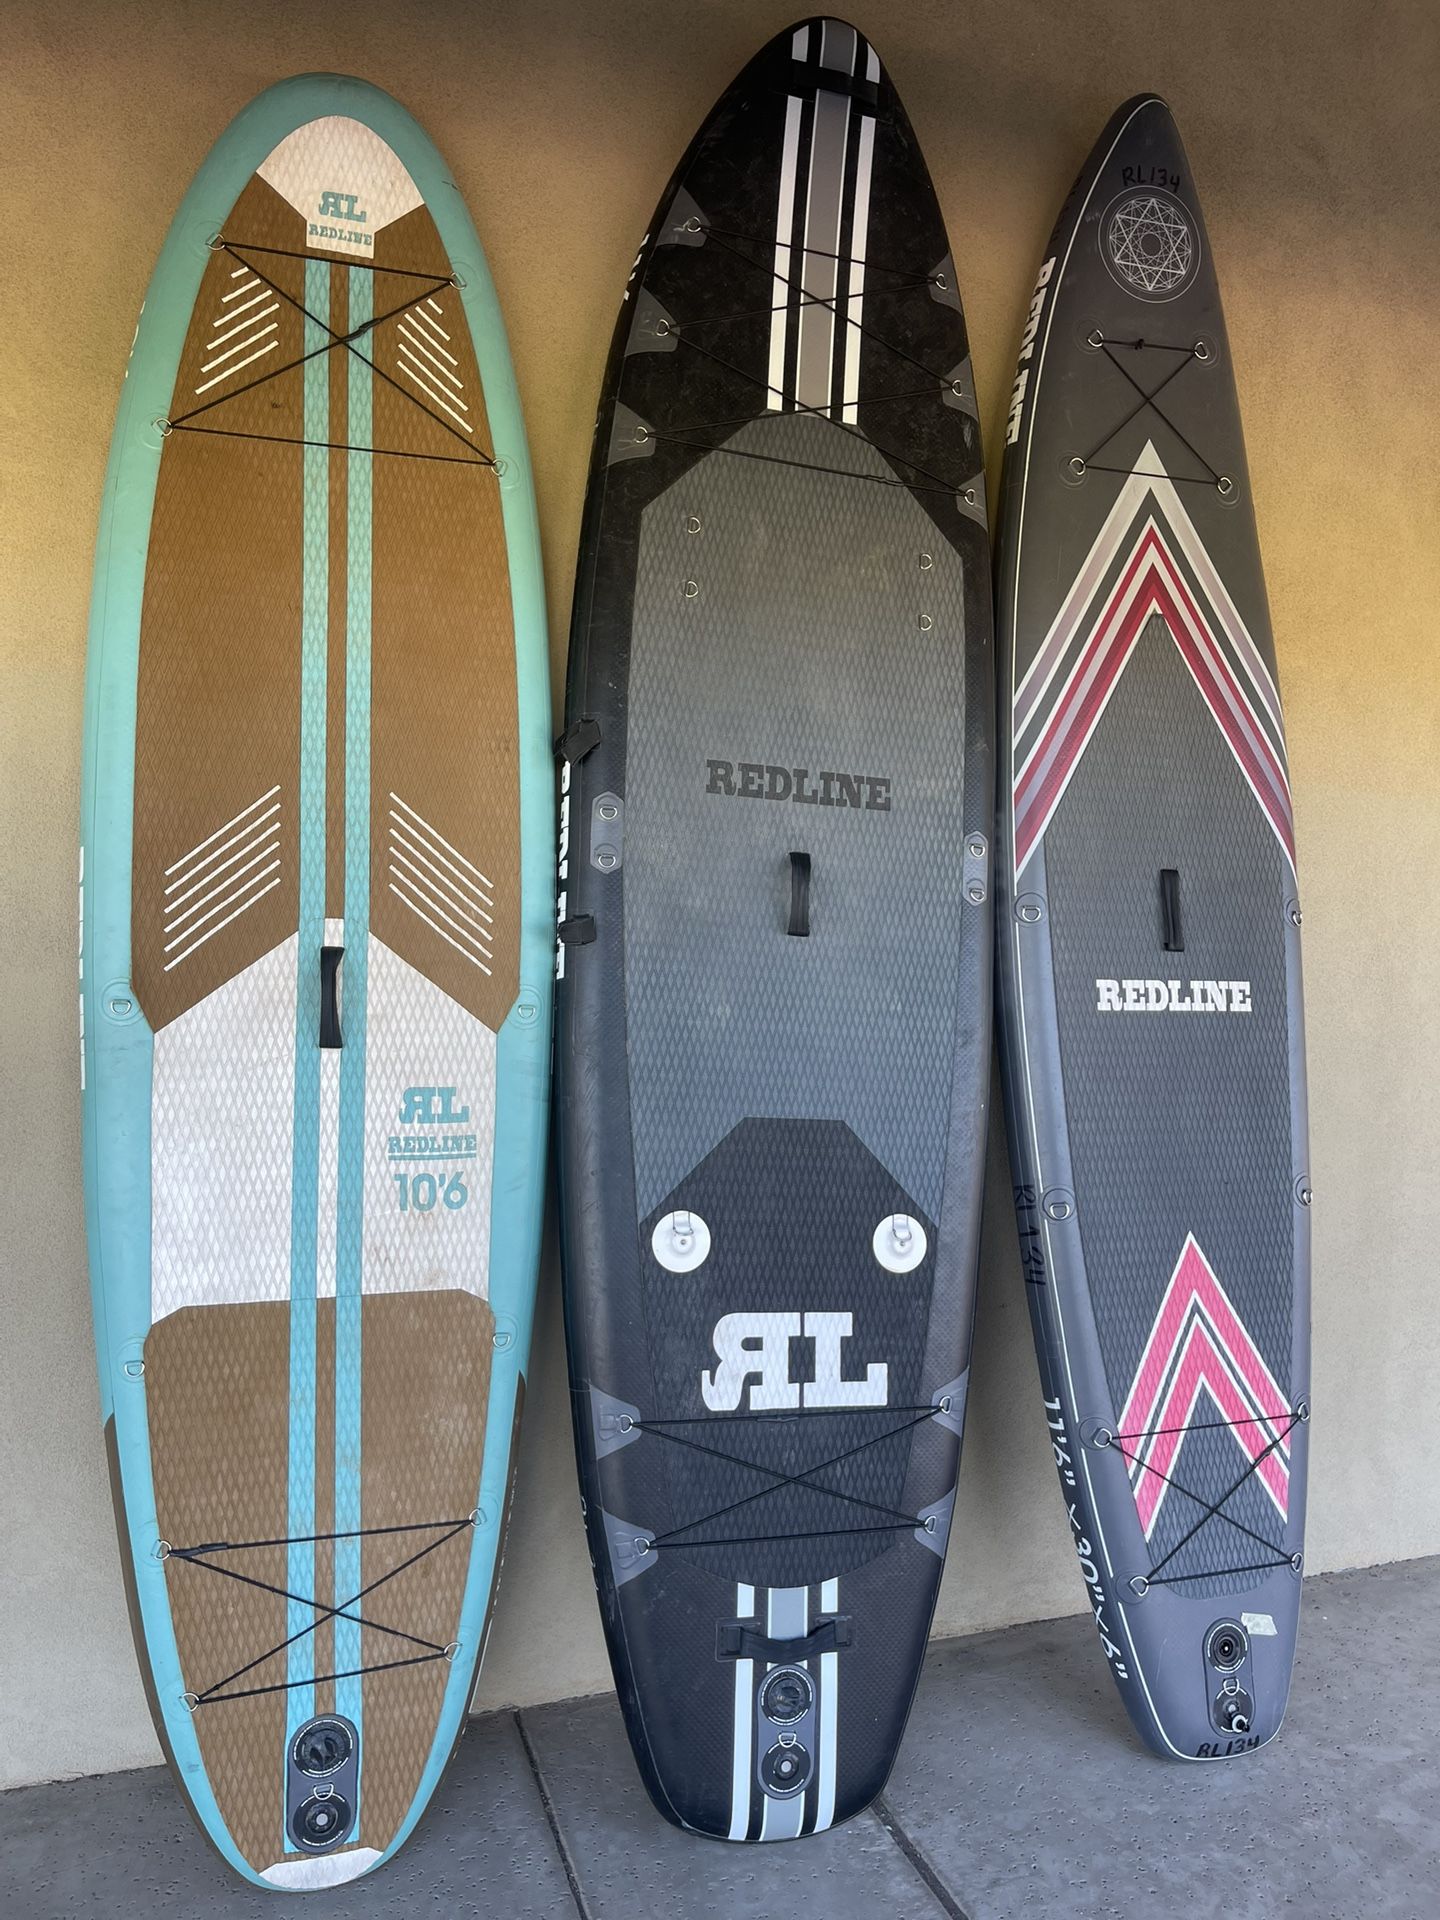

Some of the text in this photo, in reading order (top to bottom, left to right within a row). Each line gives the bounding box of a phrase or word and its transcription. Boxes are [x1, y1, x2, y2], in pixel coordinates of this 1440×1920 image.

[1121, 164, 1180, 193] RL134
[309, 223, 373, 246] REDLINE
[705, 759, 892, 811] REDLINE
[1096, 979, 1252, 1012] REDLINE
[388, 1135, 477, 1153] REDLINE
[394, 1171, 469, 1211] 10'6
[1196, 1735, 1260, 1758] RL134
